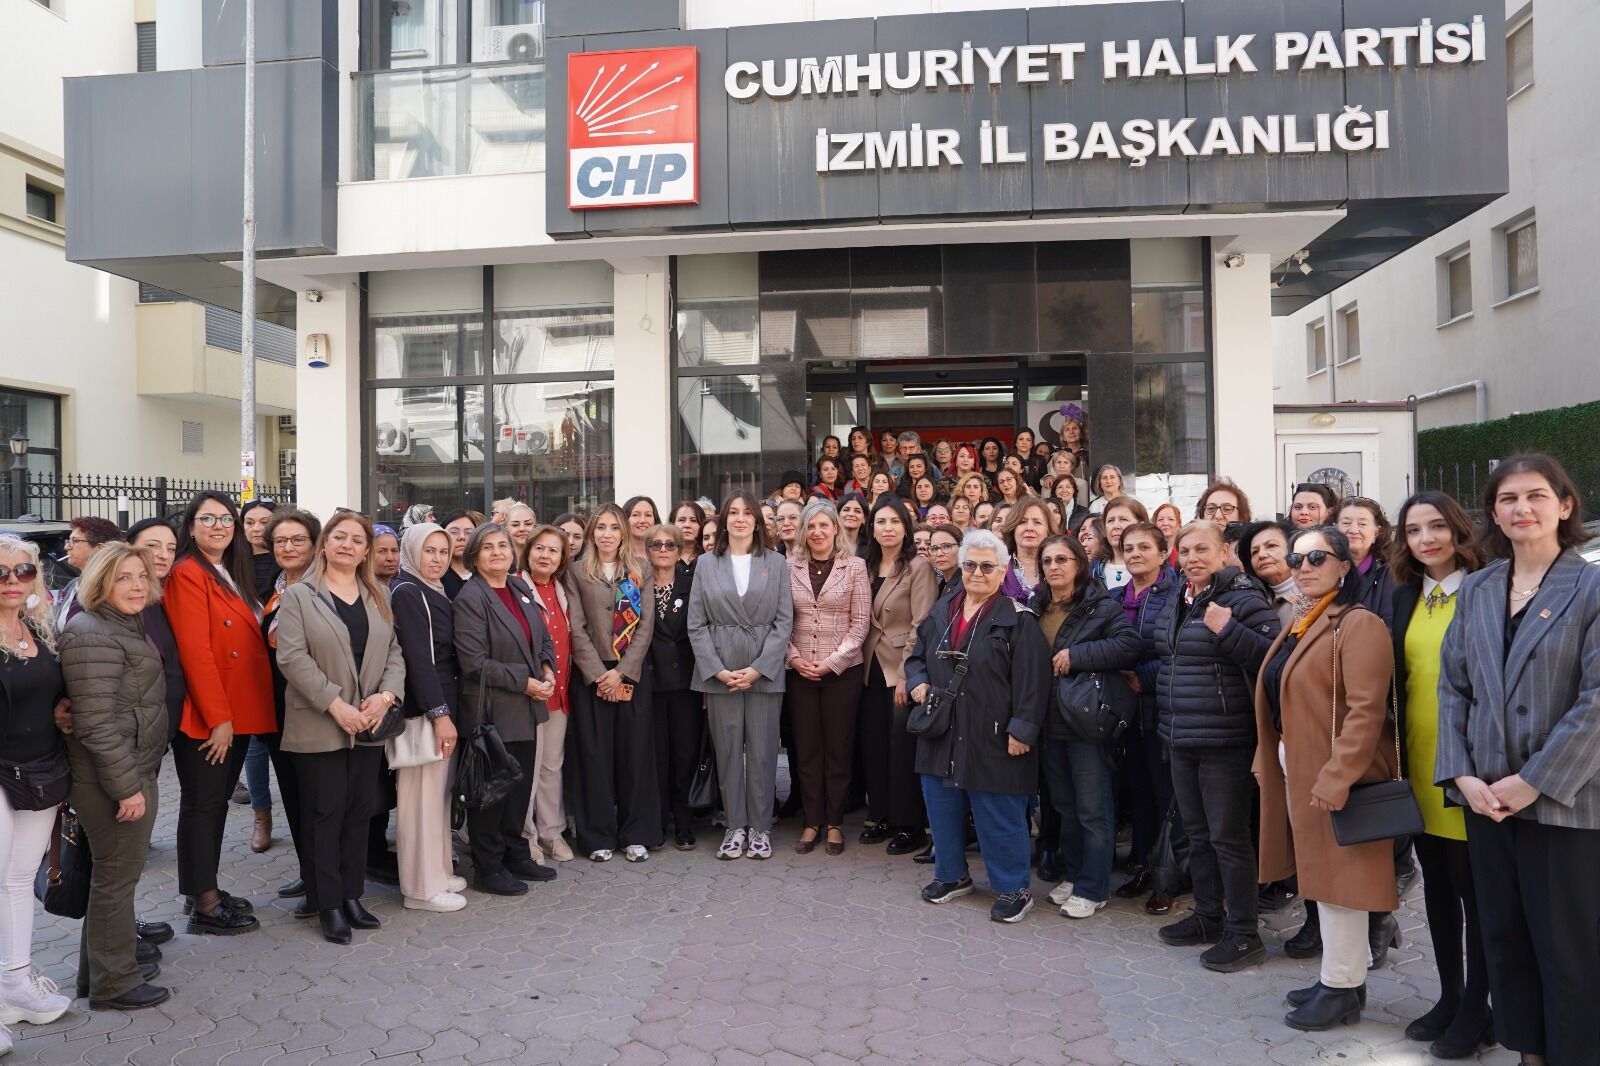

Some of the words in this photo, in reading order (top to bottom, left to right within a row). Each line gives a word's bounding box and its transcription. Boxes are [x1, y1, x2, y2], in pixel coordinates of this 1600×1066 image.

[724, 41, 1085, 98] CUMHURİYET
[1103, 34, 1257, 79] HALK
[1275, 15, 1486, 71] PARTİSİ
[815, 122, 963, 172] İZMİR
[980, 120, 1026, 164] İL
[1043, 105, 1390, 167] BAŞKANLIĞI
[577, 153, 686, 198] CHP
